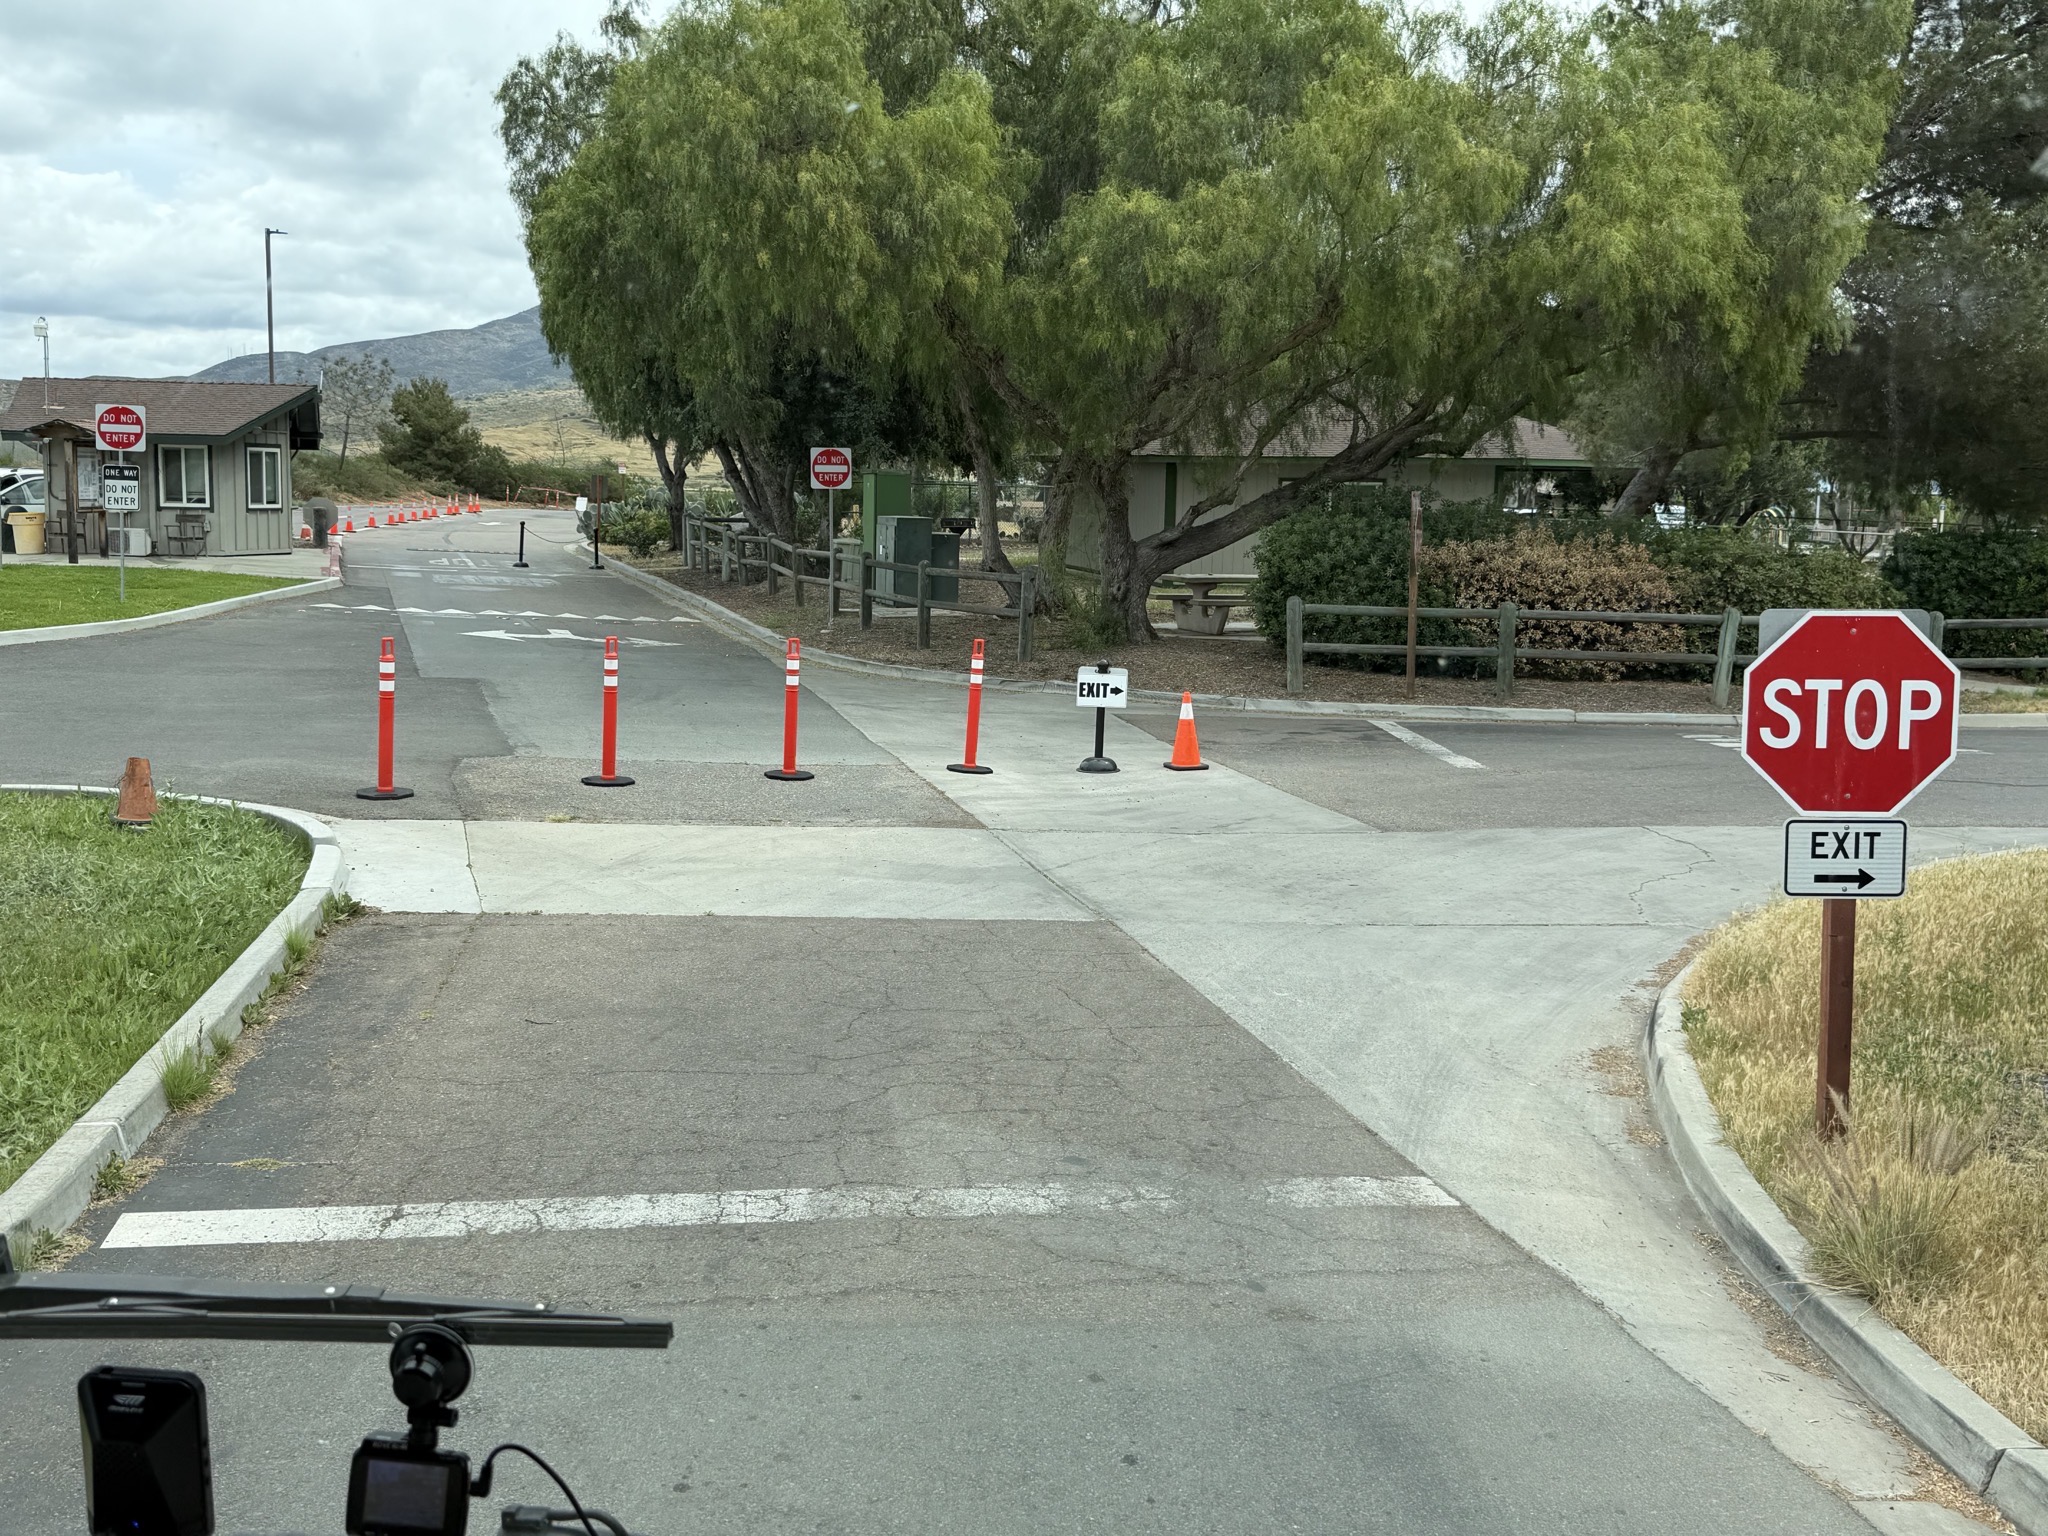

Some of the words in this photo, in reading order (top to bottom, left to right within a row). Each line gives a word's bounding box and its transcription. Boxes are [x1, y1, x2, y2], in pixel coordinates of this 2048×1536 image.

[103, 413, 116, 423] DO
[120, 414, 138, 423] NOT
[105, 433, 136, 443] ENTER
[817, 455, 827, 464] DO
[831, 455, 845, 464] NOT
[105, 468, 120, 477] ONE
[123, 469, 138, 477] WAY
[819, 473, 844, 482] ENTER
[105, 484, 118, 494] DO
[121, 485, 137, 494] NOT
[107, 496, 136, 506] ENTER
[1078, 682, 1110, 699] EXIT
[1759, 678, 1942, 750] STOP
[1810, 831, 1881, 860] EXIT
